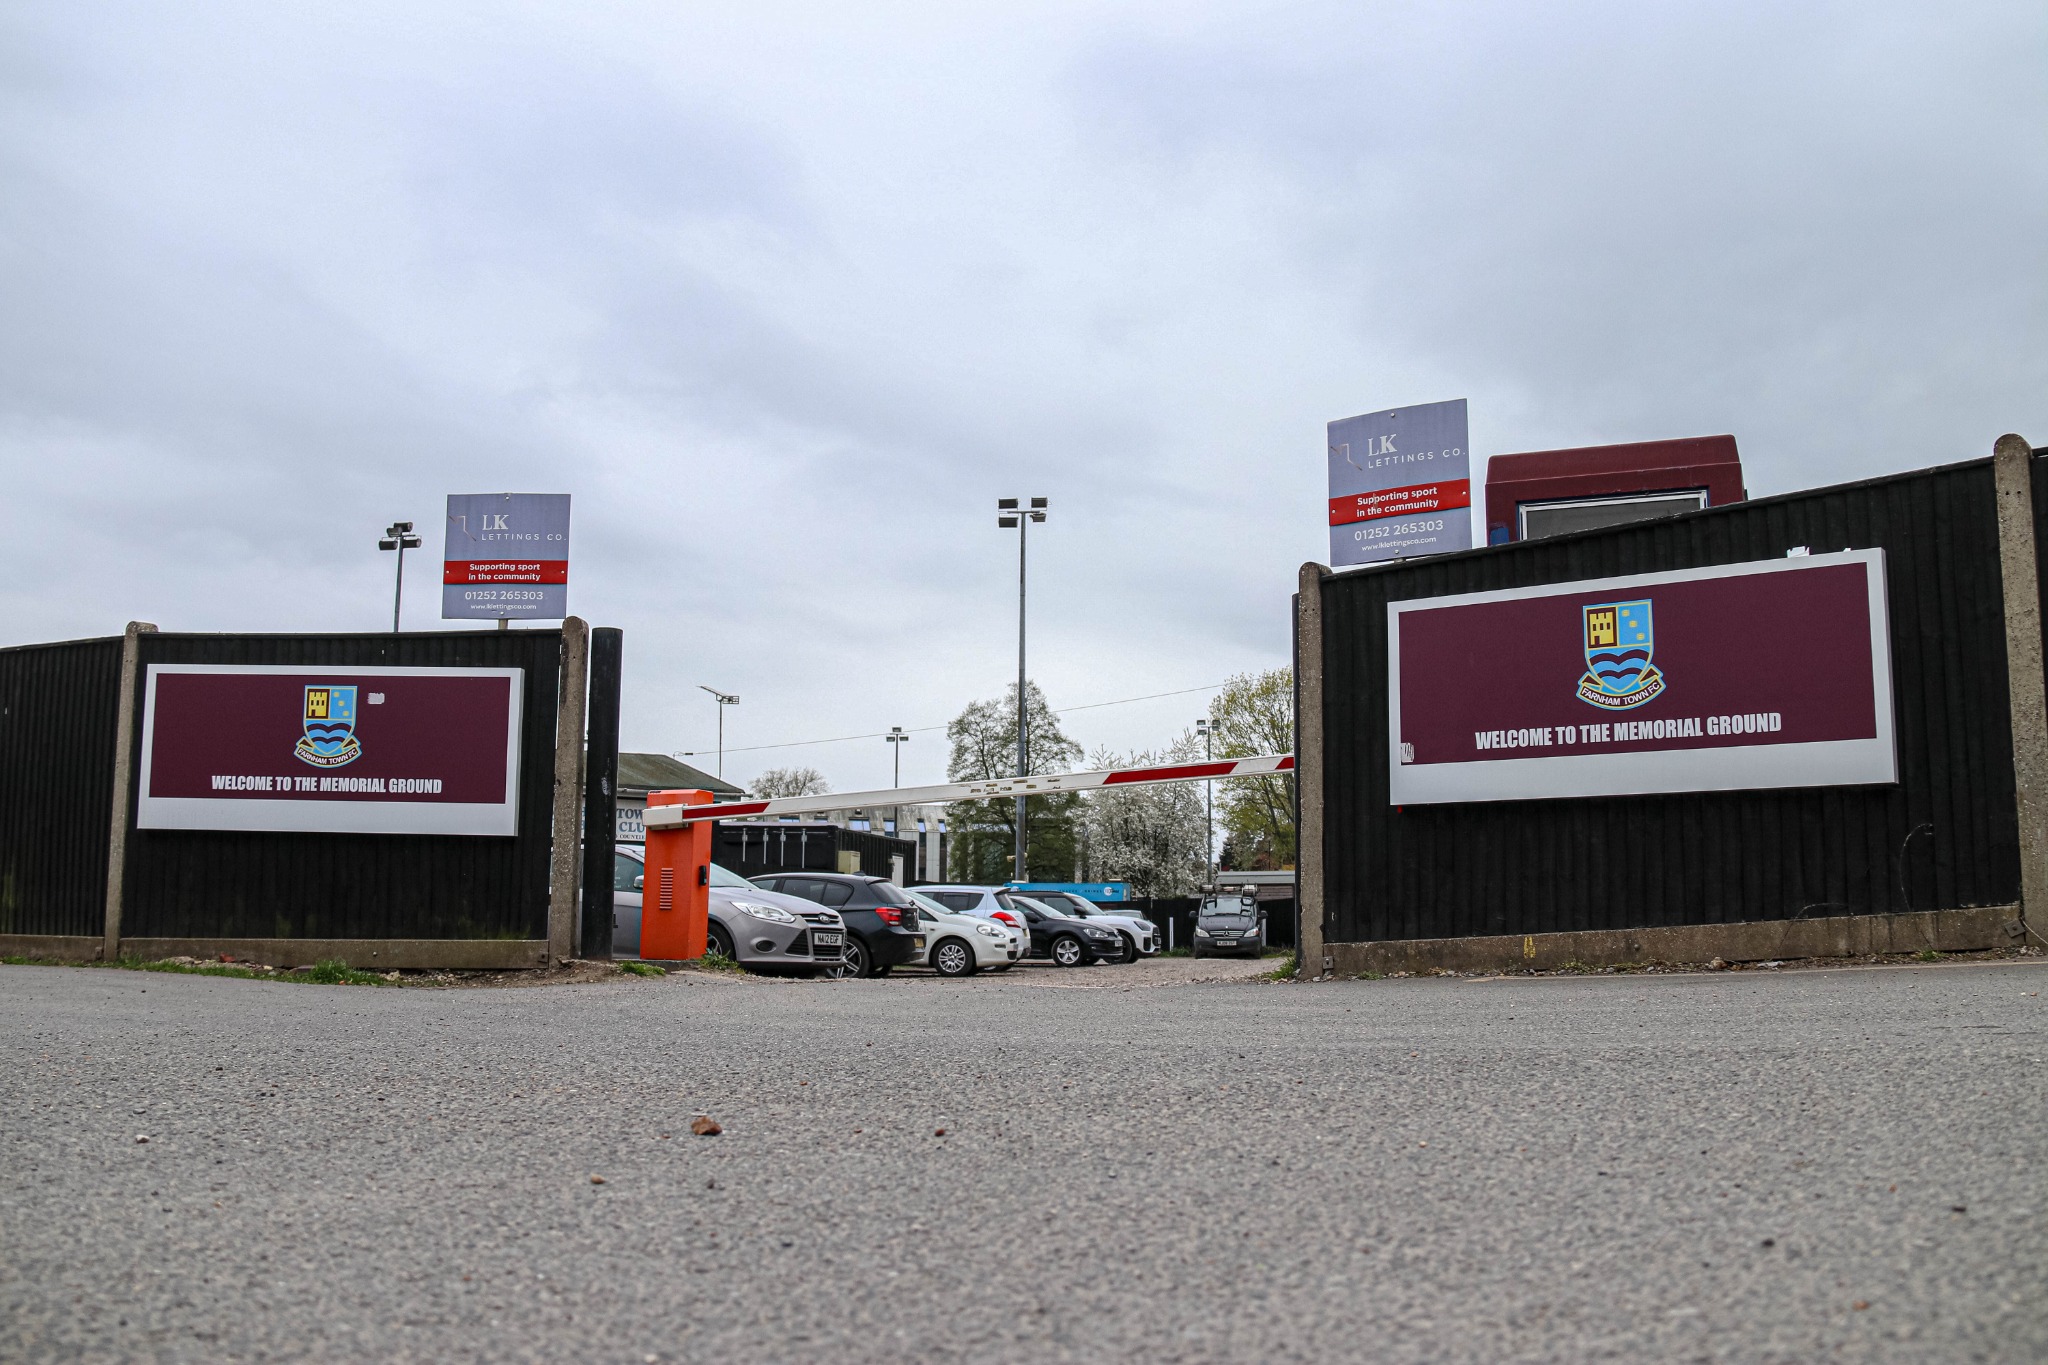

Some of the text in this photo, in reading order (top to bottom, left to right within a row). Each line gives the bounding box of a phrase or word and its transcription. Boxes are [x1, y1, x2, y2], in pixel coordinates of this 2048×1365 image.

[1368, 434, 1397, 456] LK
[1368, 448, 1466, 469] LETTINGS CO.
[1357, 486, 1438, 506] Supporting sport
[1356, 499, 1439, 518] in the community
[482, 514, 509, 531] LK
[1354, 520, 1444, 541] 01252 265303
[481, 533, 567, 541] LETTINGS CO.
[1362, 536, 1437, 552] www.lklettingsco.com
[469, 563, 541, 572] Supporting sport
[494, 573, 541, 582] community
[465, 590, 544, 600] 01252 265303
[470, 603, 537, 611] www.lklettingsco.com
[1581, 682, 1660, 706] FARNHAM TOWN FC
[1474, 712, 1782, 750] WELCOME TO THE MEMORIAL GROUND
[298, 748, 357, 765] FARNHAM TOWN FC
[211, 775, 443, 794] WELCOME TO THE MEMORIAL GROUND
